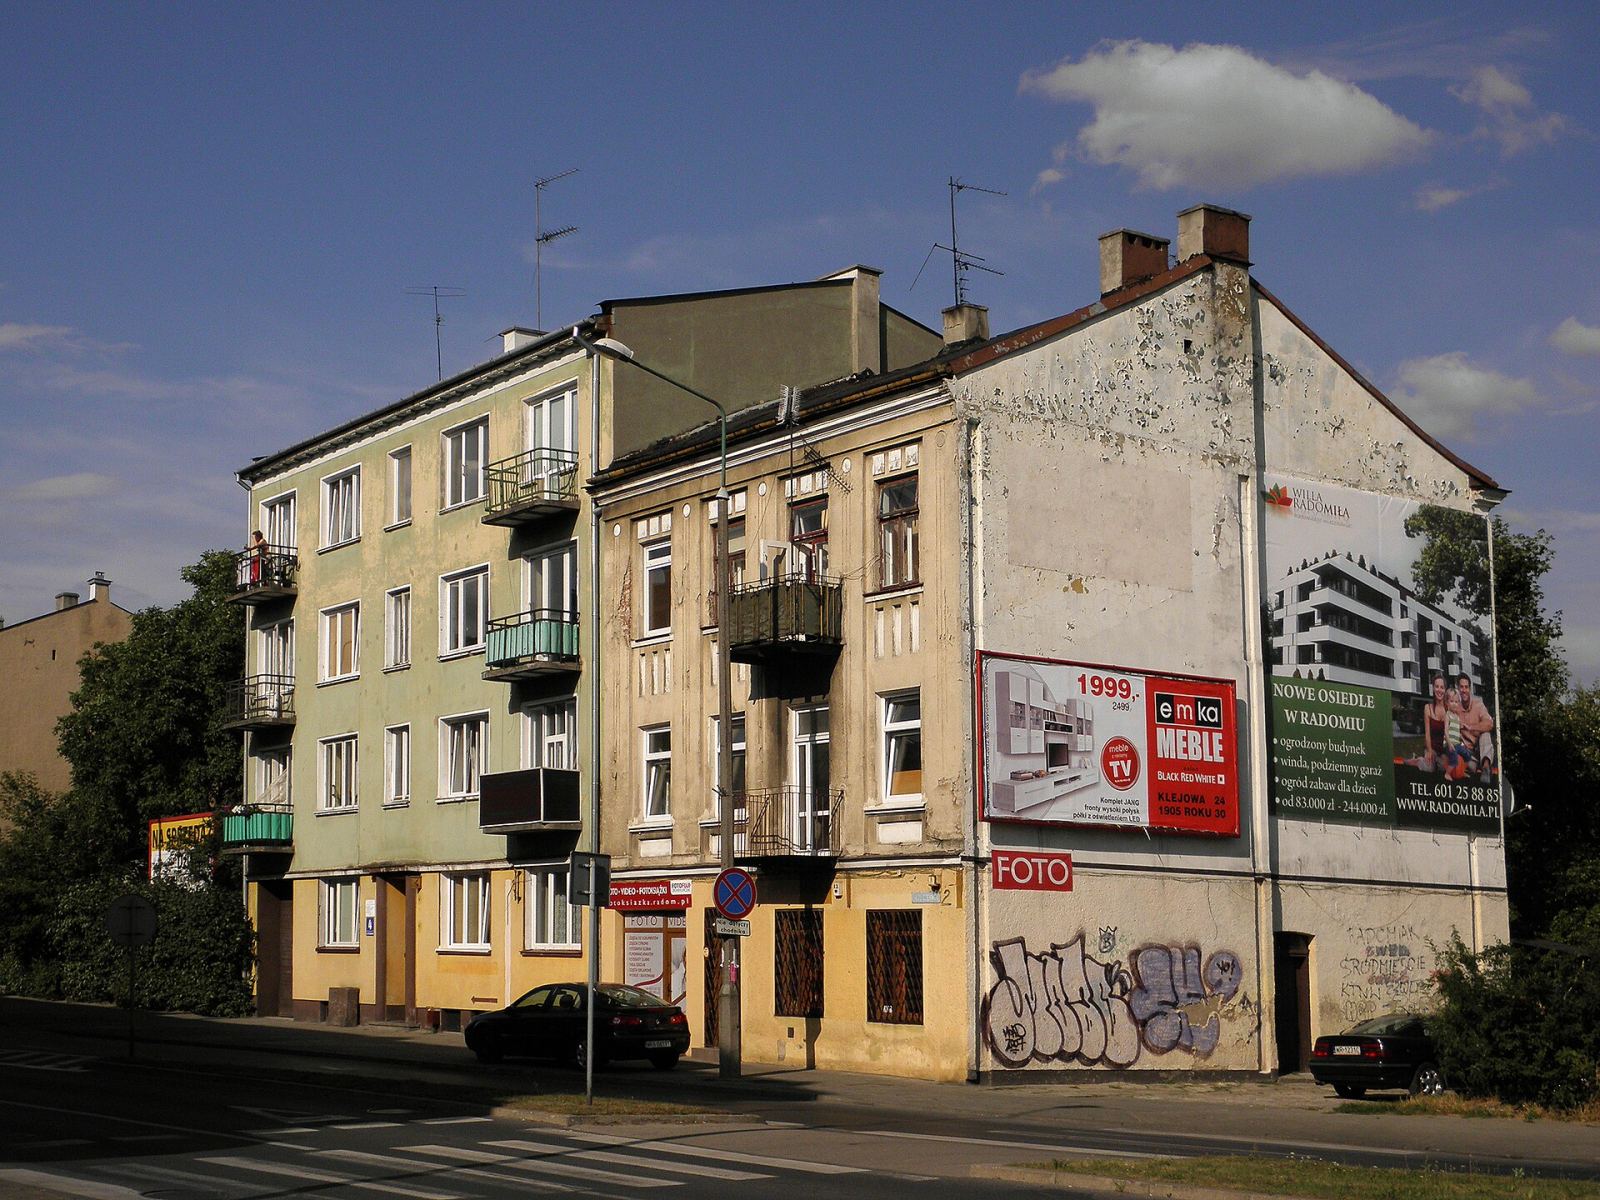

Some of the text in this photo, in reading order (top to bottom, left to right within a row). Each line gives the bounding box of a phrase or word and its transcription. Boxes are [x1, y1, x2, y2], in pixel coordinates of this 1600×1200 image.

[1292, 487, 1323, 502] WILLA
[1273, 683, 1375, 709] NOWE OSIEDLE
[1160, 701, 1218, 723] emka
[1284, 709, 1366, 732] W RADOMIU
[1156, 727, 1225, 762] MEBLE
[1280, 736, 1366, 756] ogrodzony budynek
[1109, 760, 1132, 778] TV
[1280, 755, 1382, 778] winda, podziemny garaż
[1157, 770, 1216, 784] BLACK RED WHITE
[1281, 775, 1377, 795] ogród zabaw dla dzieci
[1100, 797, 1123, 805] Komplet
[1158, 792, 1226, 805] KLEJOWA 24
[1410, 782, 1499, 803] TEL. 601 25 88 85
[1084, 804, 1101, 812] fronty
[1159, 806, 1226, 818] 1905 ROKU 30
[1282, 795, 1294, 807] od
[1295, 796, 1326, 810] 83.000
[1327, 798, 1335, 811] zł
[1343, 800, 1377, 814] 244.000
[1397, 797, 1500, 818] WWW.RADOMILA.PL
[152, 828, 165, 850] NA
[997, 856, 1069, 885] FOTO
[621, 887, 636, 896] VIDEO
[631, 916, 686, 926] FOTO VIDE
